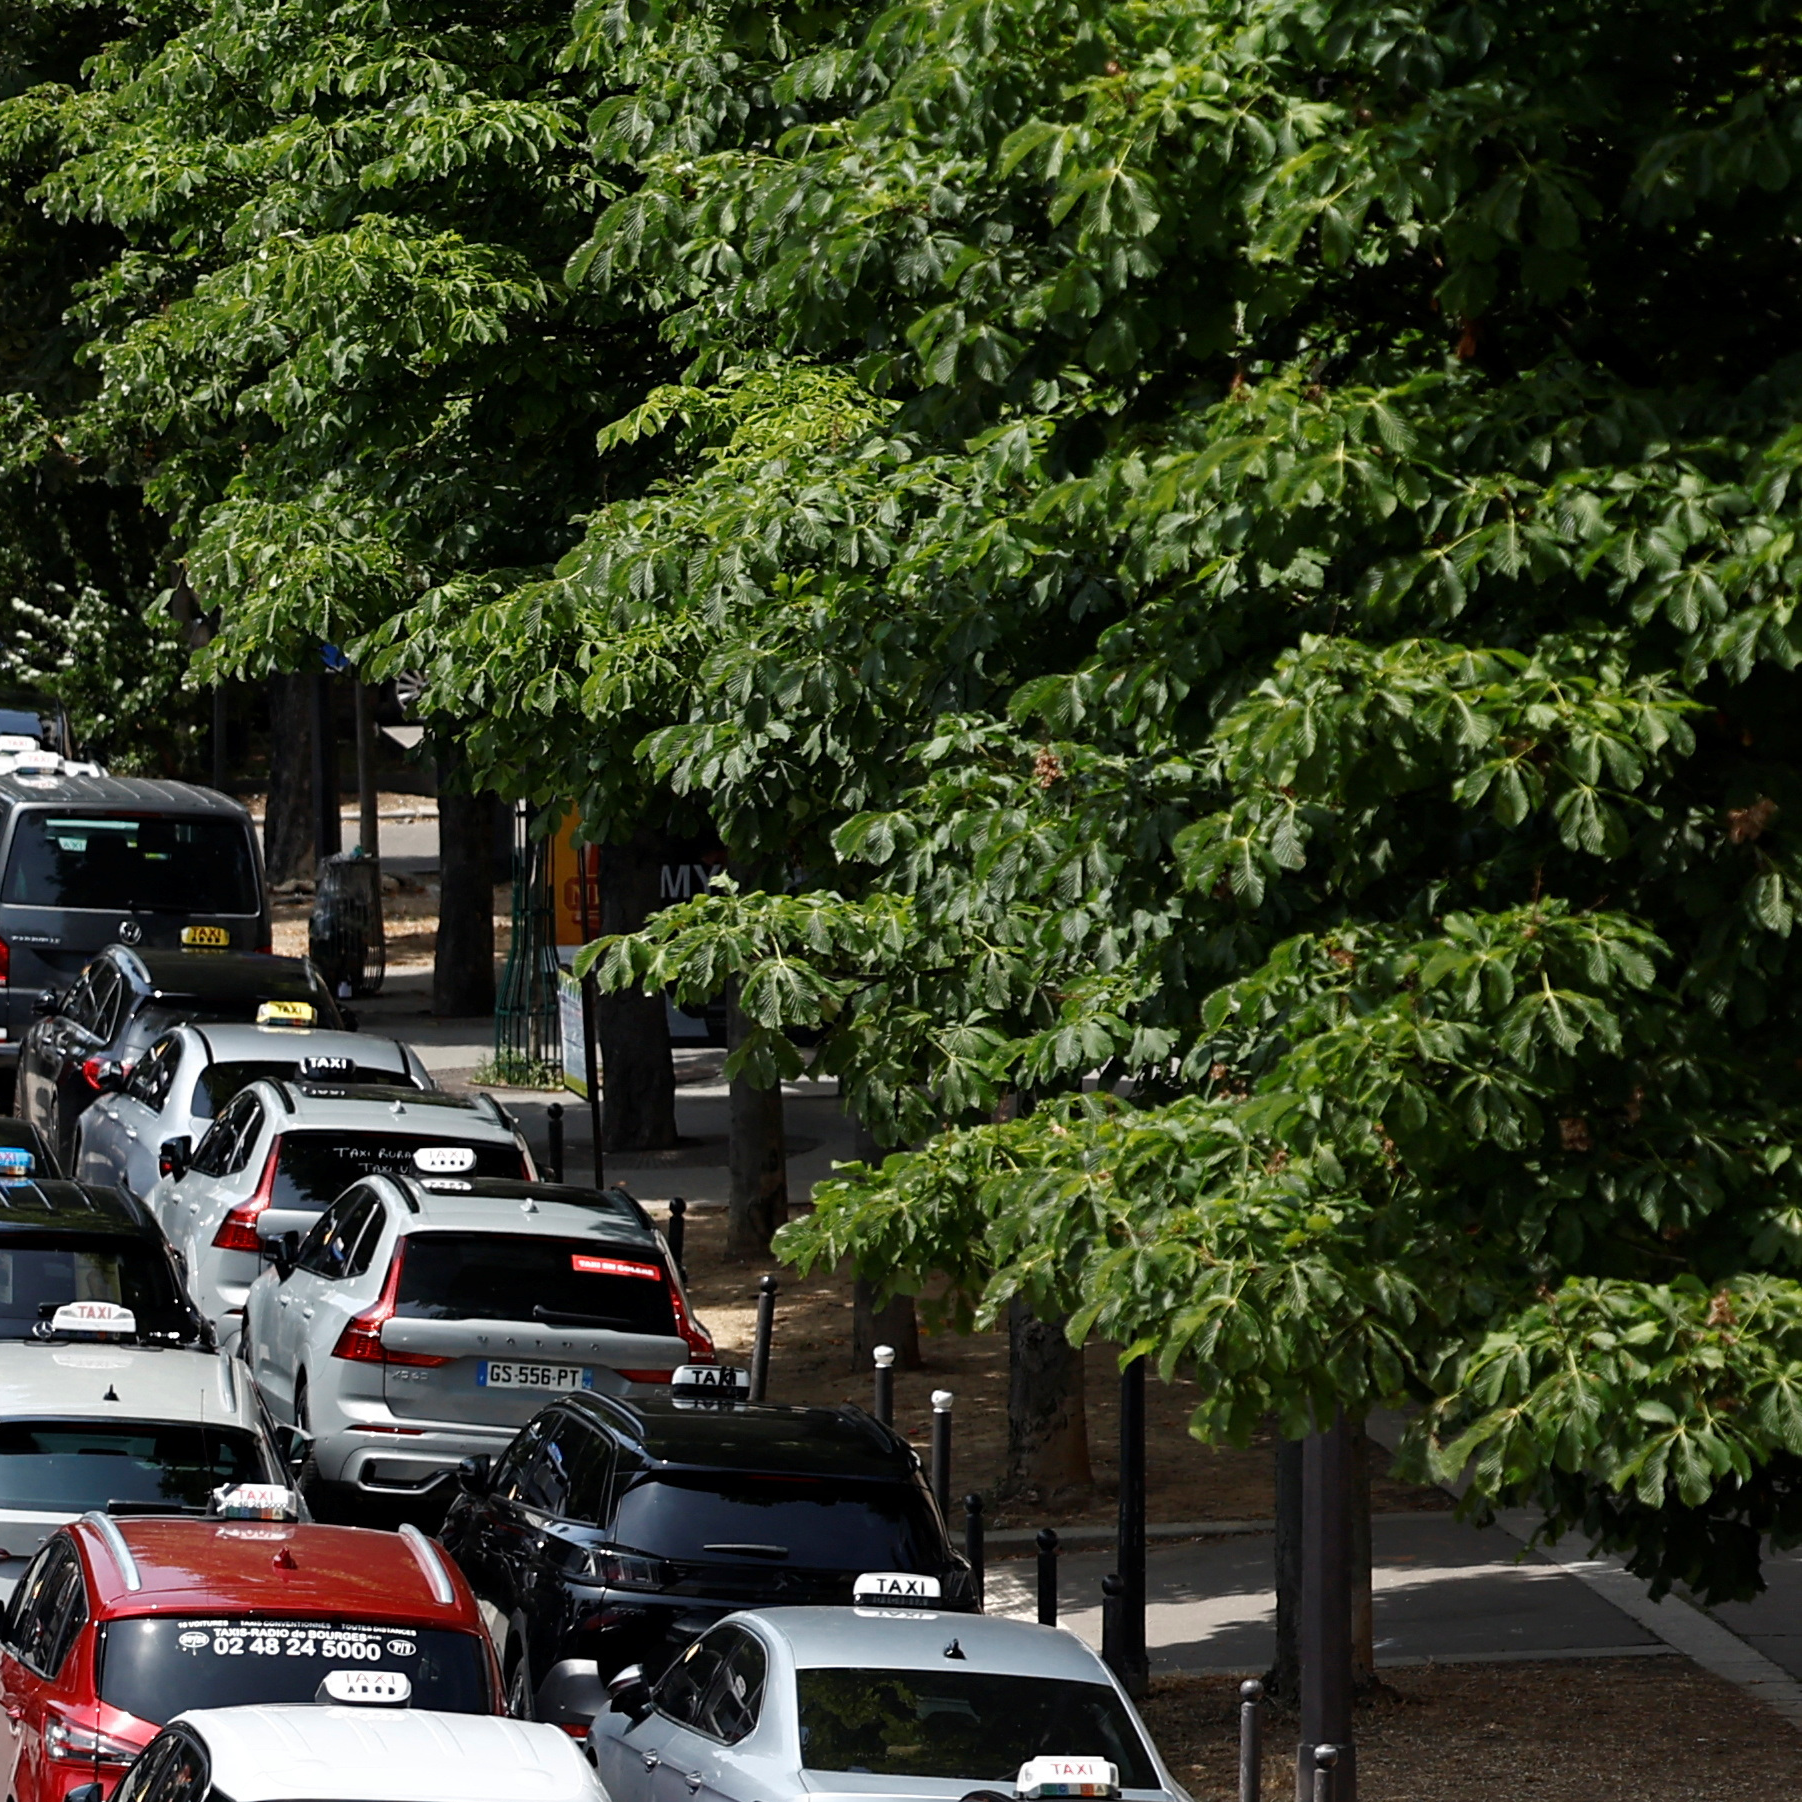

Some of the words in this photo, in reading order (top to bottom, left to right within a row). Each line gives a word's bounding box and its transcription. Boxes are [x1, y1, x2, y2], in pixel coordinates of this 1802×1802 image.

[192, 927, 222, 937] TAXI
[277, 1004, 303, 1015] TAXI
[308, 1057, 347, 1069] TAXI
[333, 1147, 374, 1158] TAXI
[378, 1148, 414, 1159] RURA
[429, 1151, 465, 1159] TAXI
[359, 1162, 393, 1174] TAXI
[77, 1305, 112, 1320] TAXI
[489, 1364, 580, 1388] GS-556-PT
[691, 1369, 743, 1385] TAXI
[238, 1490, 274, 1501] TAXI
[876, 1578, 925, 1595] TAXI
[188, 1620, 228, 1628] VOITURES
[341, 1623, 372, 1632] TOUTES
[373, 1627, 417, 1636] DISTANCES
[214, 1628, 290, 1638] TAXIS-RADIO
[291, 1629, 305, 1640] de
[308, 1631, 366, 1642] BOURGES
[213, 1637, 245, 1656] 02
[248, 1637, 280, 1657] 48
[285, 1639, 316, 1658] 24
[322, 1640, 382, 1661] 5000
[346, 1672, 395, 1685] TAXI
[1053, 1764, 1094, 1776] TAXI
